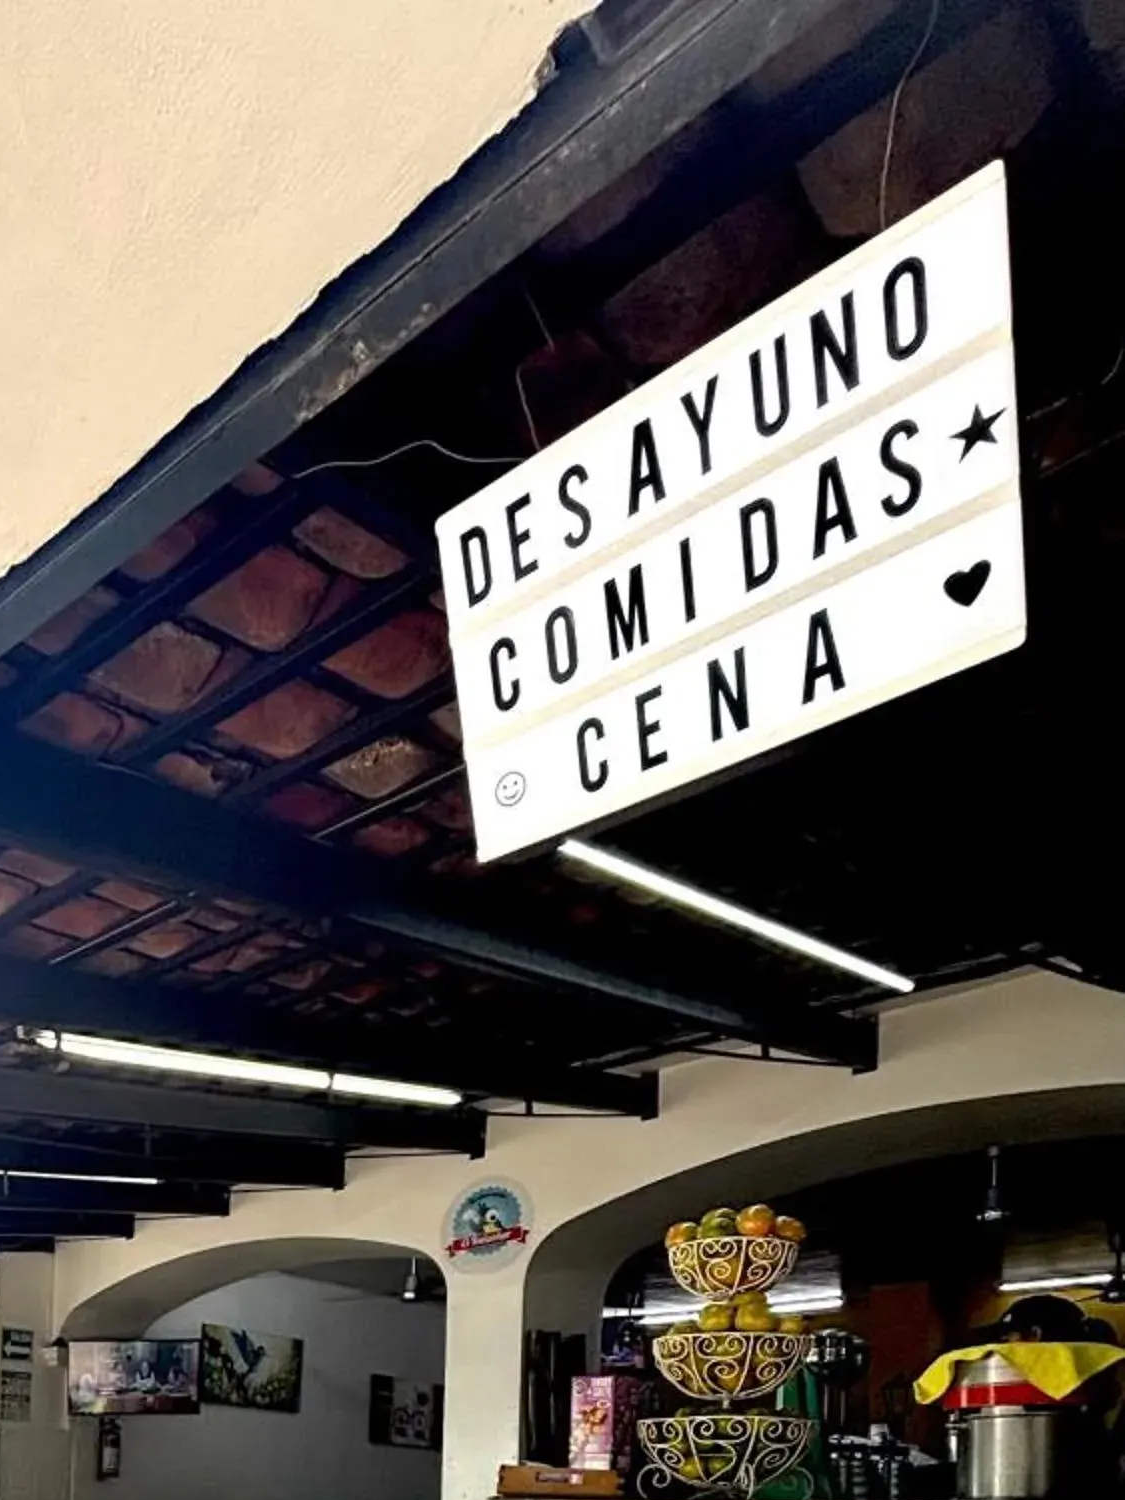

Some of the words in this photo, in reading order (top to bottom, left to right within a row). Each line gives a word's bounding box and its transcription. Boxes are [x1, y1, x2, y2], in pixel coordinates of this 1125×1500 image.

[459, 255, 928, 608] DESAYUNO
[488, 418, 922, 712] COMIDAS
[575, 607, 847, 793] CENA
